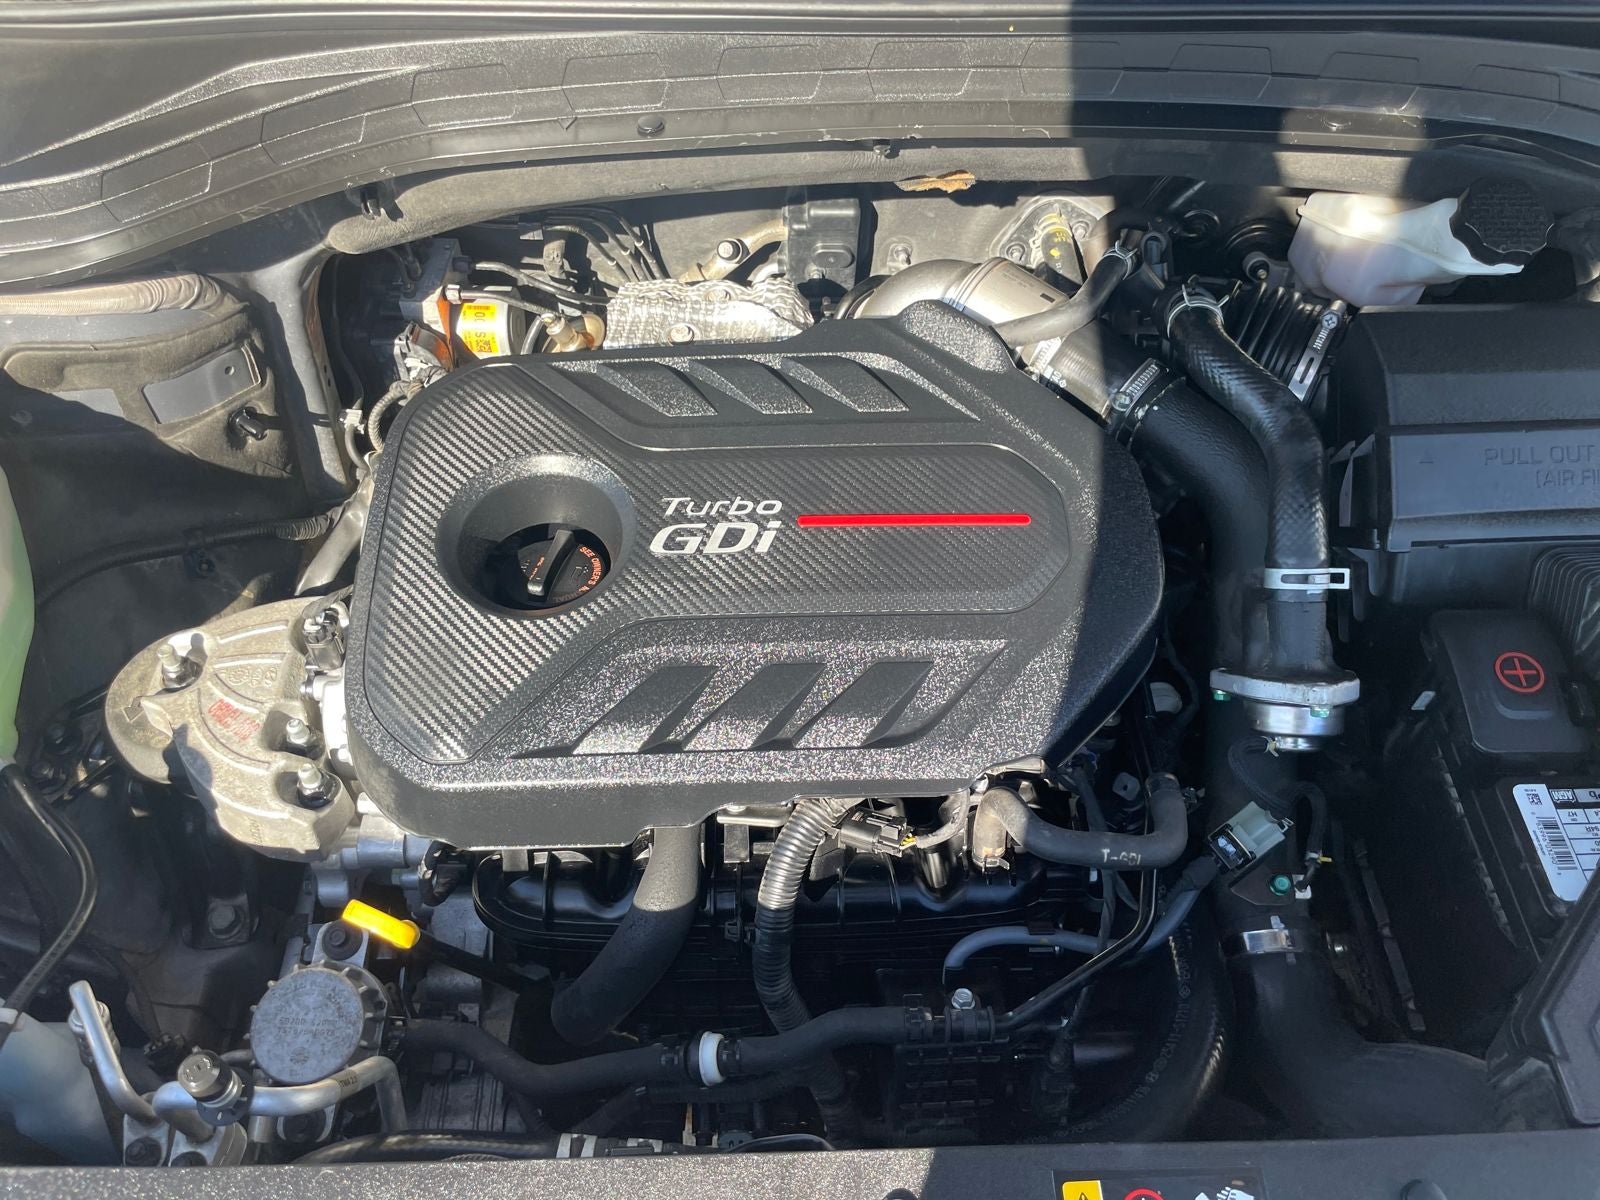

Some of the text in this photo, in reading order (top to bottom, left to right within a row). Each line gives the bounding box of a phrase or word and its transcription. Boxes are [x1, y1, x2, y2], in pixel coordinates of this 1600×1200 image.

[1484, 444, 1596, 466] PULL OUT
[662, 496, 783, 515] Turbo
[649, 520, 782, 553] GDi
[580, 547, 596, 557] SEE
[1552, 791, 1573, 800] AGM
[1101, 848, 1141, 866] T-GDI
